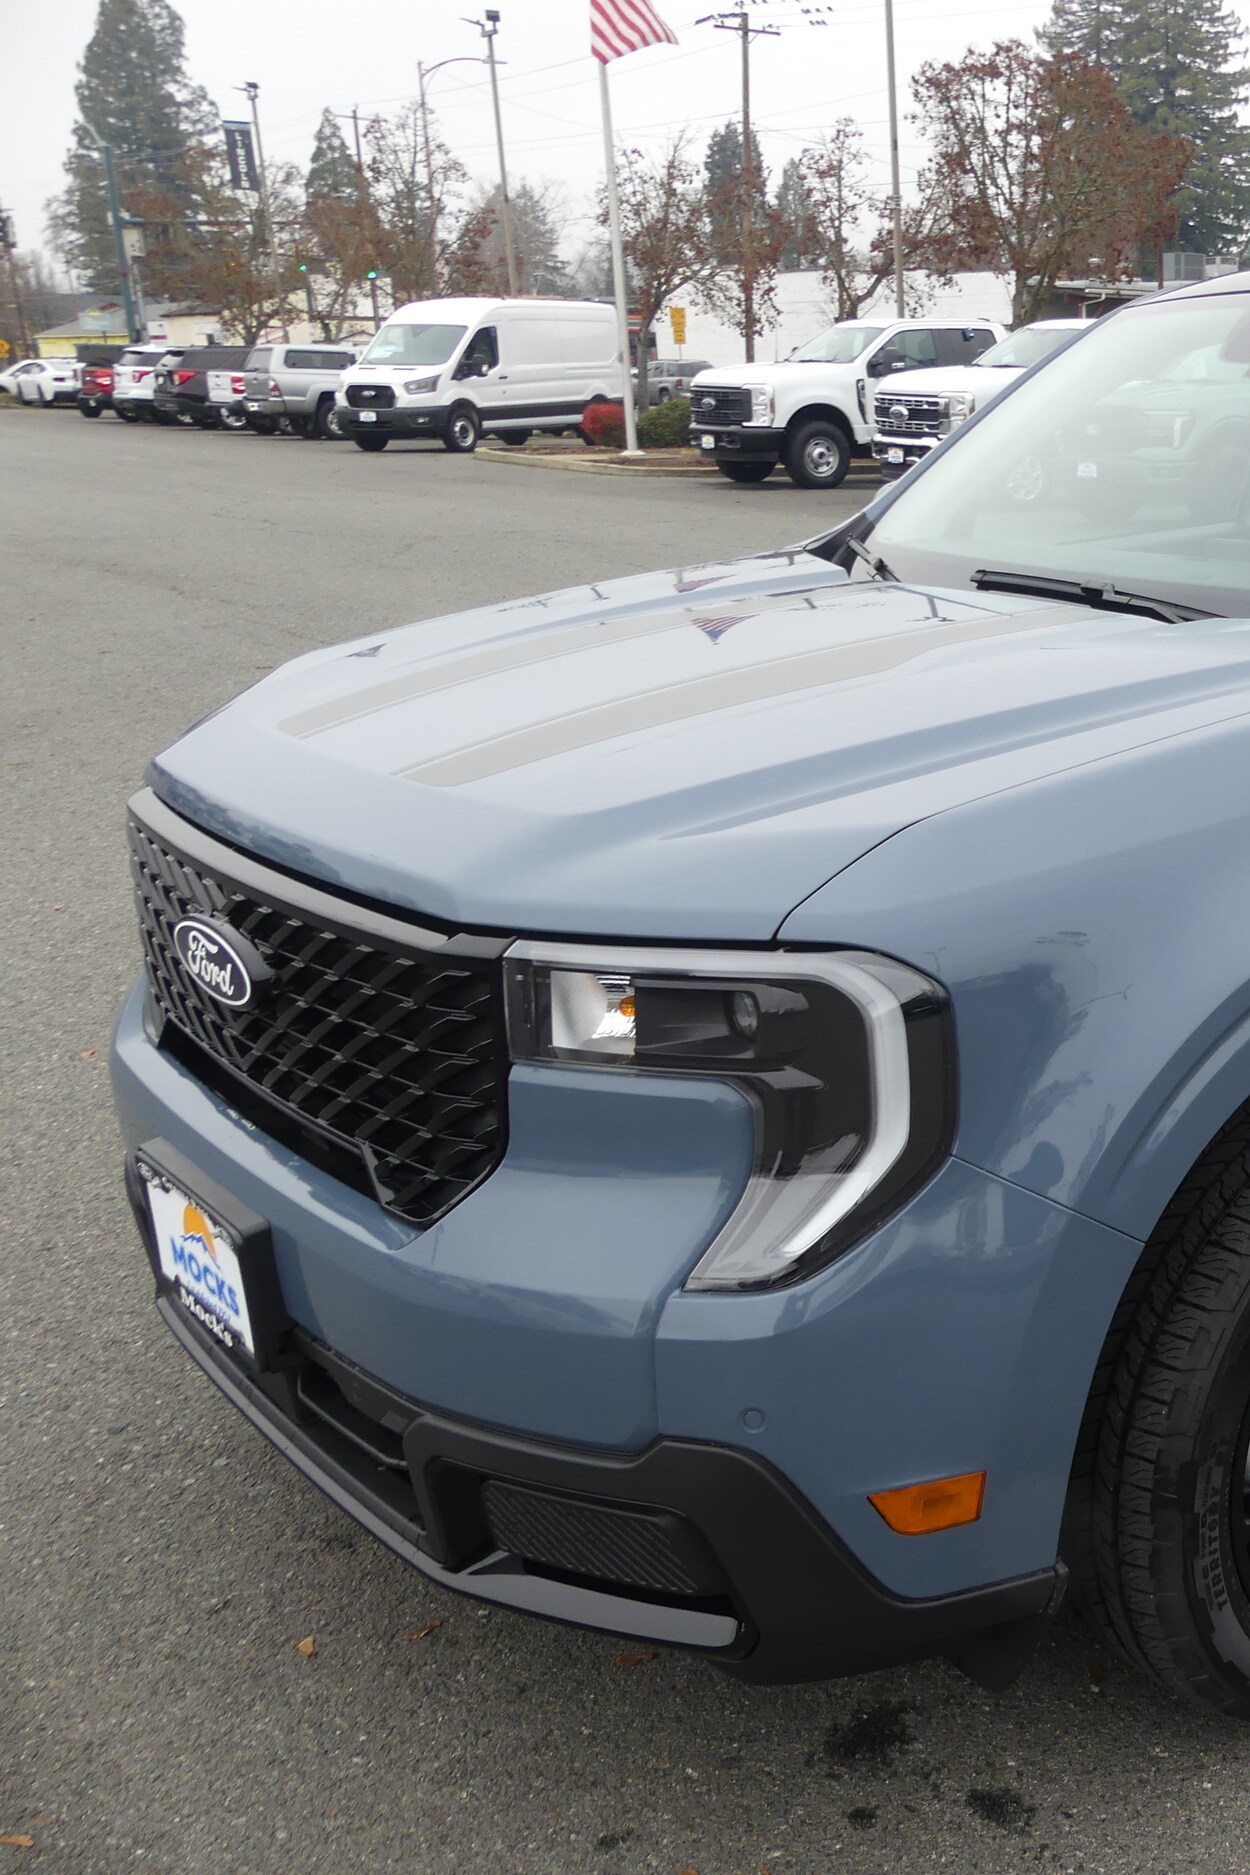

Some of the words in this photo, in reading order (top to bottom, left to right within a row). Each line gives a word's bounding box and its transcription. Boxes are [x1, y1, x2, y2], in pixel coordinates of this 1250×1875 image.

[188, 930, 235, 996] Ford
[170, 1236, 240, 1318] MOCKS
[1206, 1485, 1230, 1612] TERRITORY
